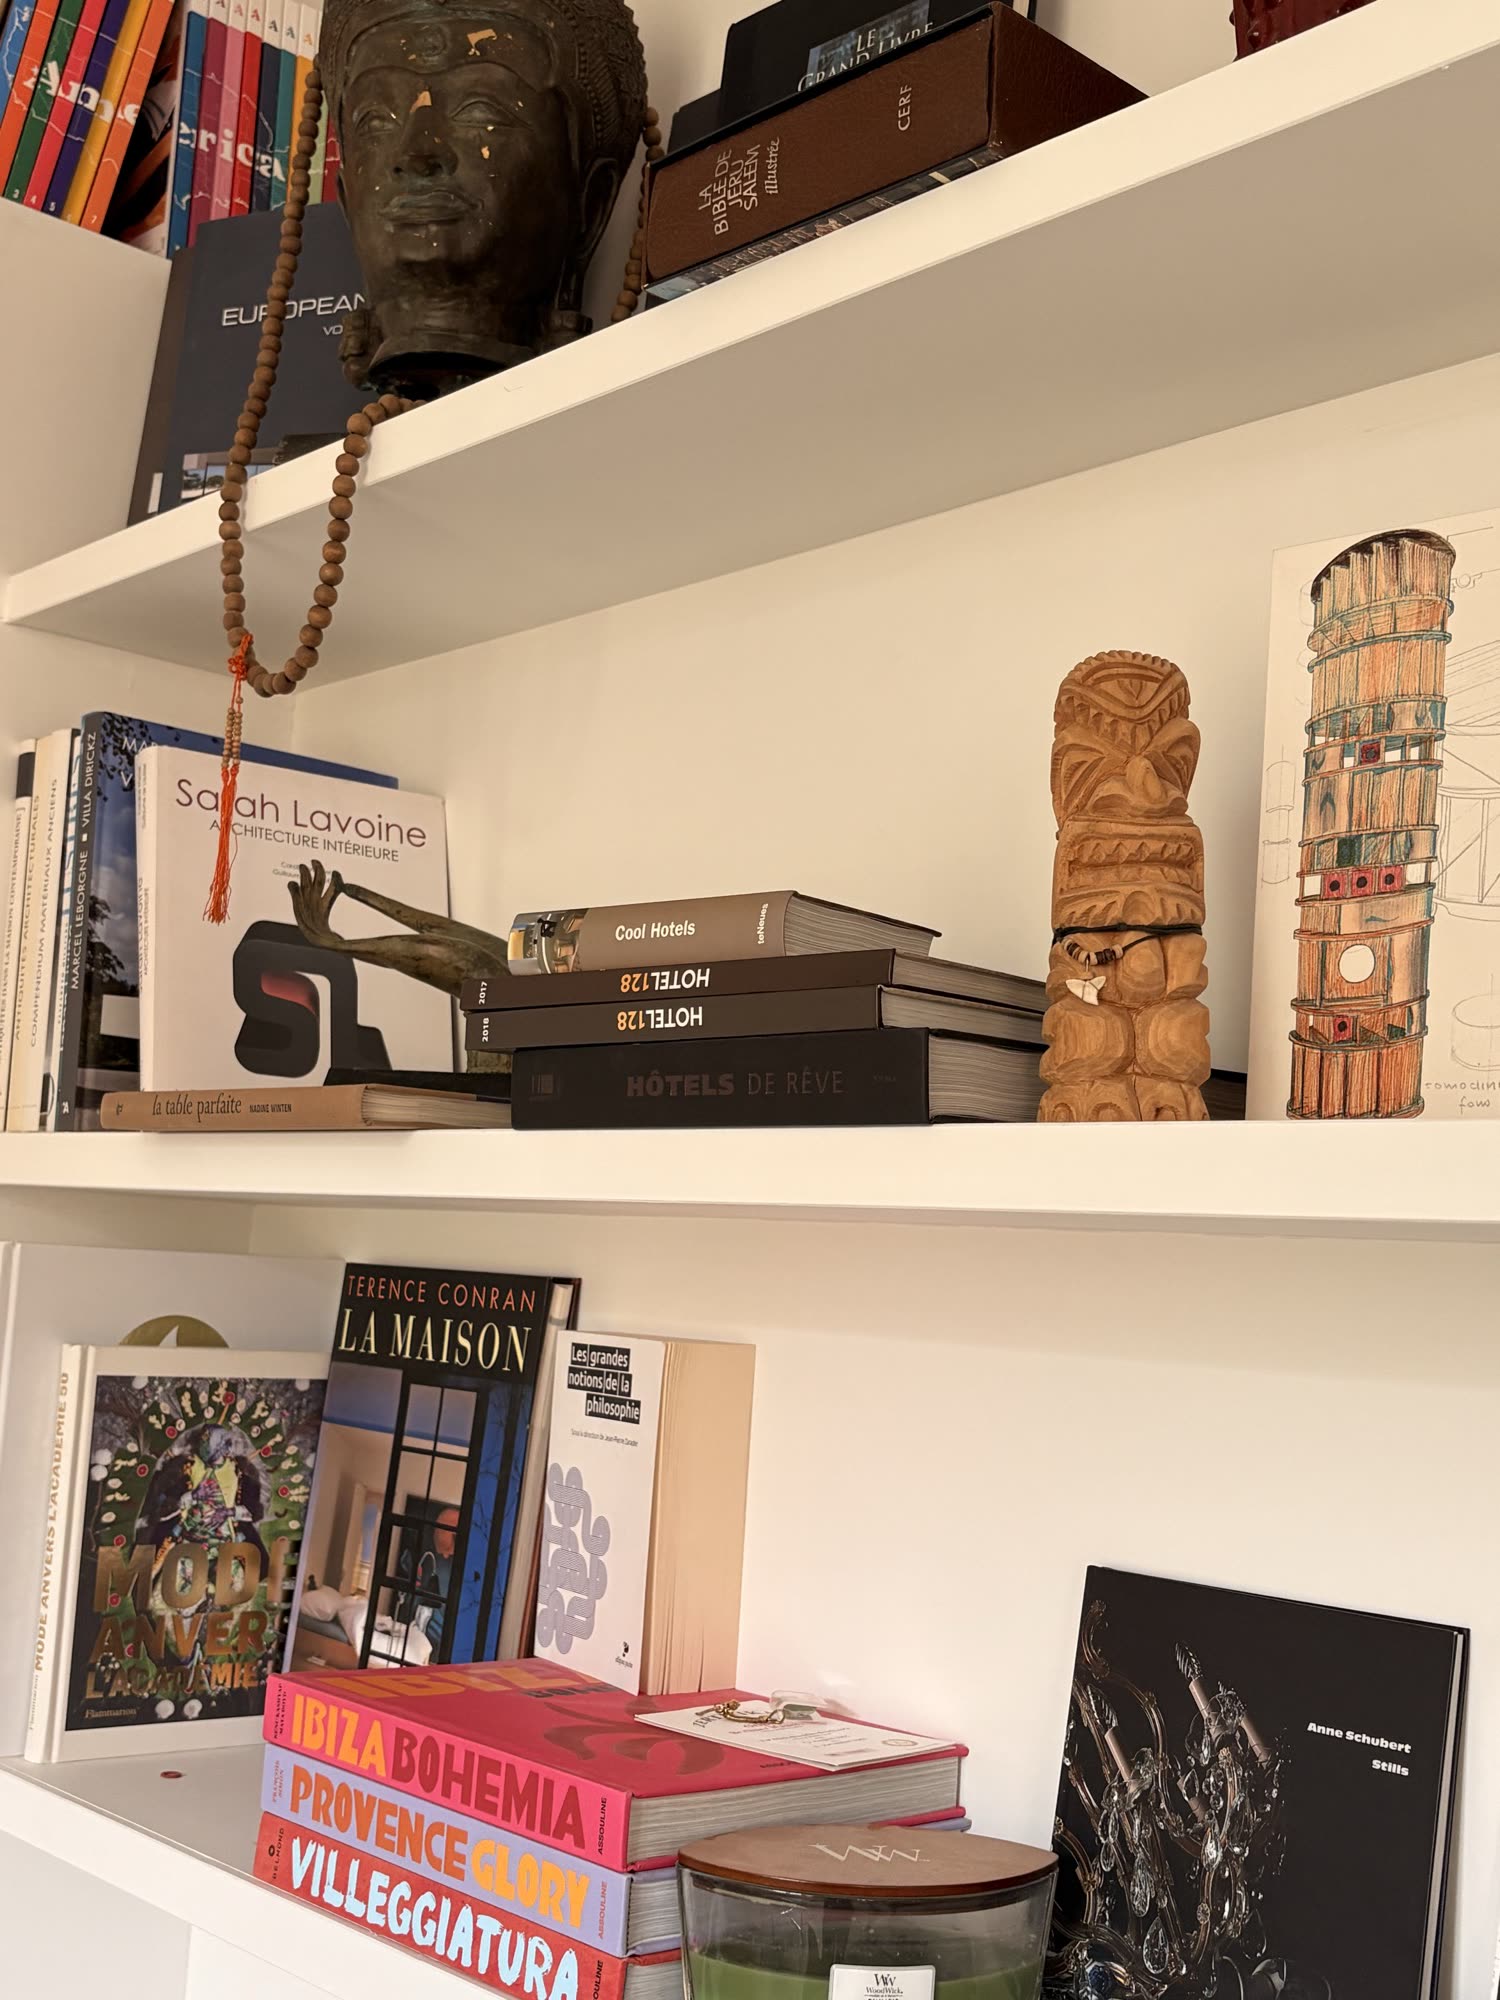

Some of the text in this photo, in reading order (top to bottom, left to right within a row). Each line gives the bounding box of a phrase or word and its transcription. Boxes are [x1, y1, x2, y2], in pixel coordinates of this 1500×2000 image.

[251, 8, 261, 21] A
[268, 19, 279, 32] A
[285, 26, 296, 39] A
[303, 32, 313, 46] A
[857, 28, 877, 52] LE
[897, 84, 913, 132] CERF
[712, 149, 732, 235] BIBLE DE
[727, 160, 744, 208] JERU
[742, 144, 761, 211] SALEM
[698, 185, 713, 210] LA
[84, 732, 97, 786] DIRICKZ
[82, 790, 93, 828] VILLA
[175, 778, 280, 823] Saah
[293, 799, 427, 848] Lavoine
[209, 819, 400, 864] ACHITECTURE INTÉRIEURE
[22, 795, 40, 940] ARCHITECTURALES
[75, 850, 89, 928] LEBORGNE
[30, 937, 45, 1048] COMPENDIUM
[48, 779, 58, 842] ANCIENS
[614, 919, 696, 941] Cool Hotels
[71, 929, 84, 990] MARCEL
[478, 981, 488, 1005] 2017
[481, 1017, 490, 1043] 2018
[626, 1066, 845, 1096] HÔTELS DE RÊVE
[152, 1093, 242, 1123] la table parfaite
[347, 1275, 536, 1313] TERENCE CONRAN
[338, 1308, 532, 1374] LA MAISON
[571, 1345, 629, 1368] Les grandes
[568, 1370, 630, 1394] notions de la
[586, 1396, 640, 1422] philosophie
[34, 1616, 48, 1672] MODE
[41, 1527, 56, 1614] ANVERS
[60, 1372, 70, 1397] 50
[85, 1708, 138, 1719] Flammarion
[1306, 1721, 1412, 1754] Anne Schubert
[291, 1694, 586, 1850] IBIZA BOHEMIA
[1371, 1759, 1410, 1777] Stills
[597, 1797, 608, 1855] ASSOULINE
[290, 1764, 591, 1929] PROVENCE GLORY
[291, 1836, 579, 2000] VILLEGGIATURA
[597, 1880, 608, 1939] ASSOULINE
[592, 1959, 604, 2000] OULINE
